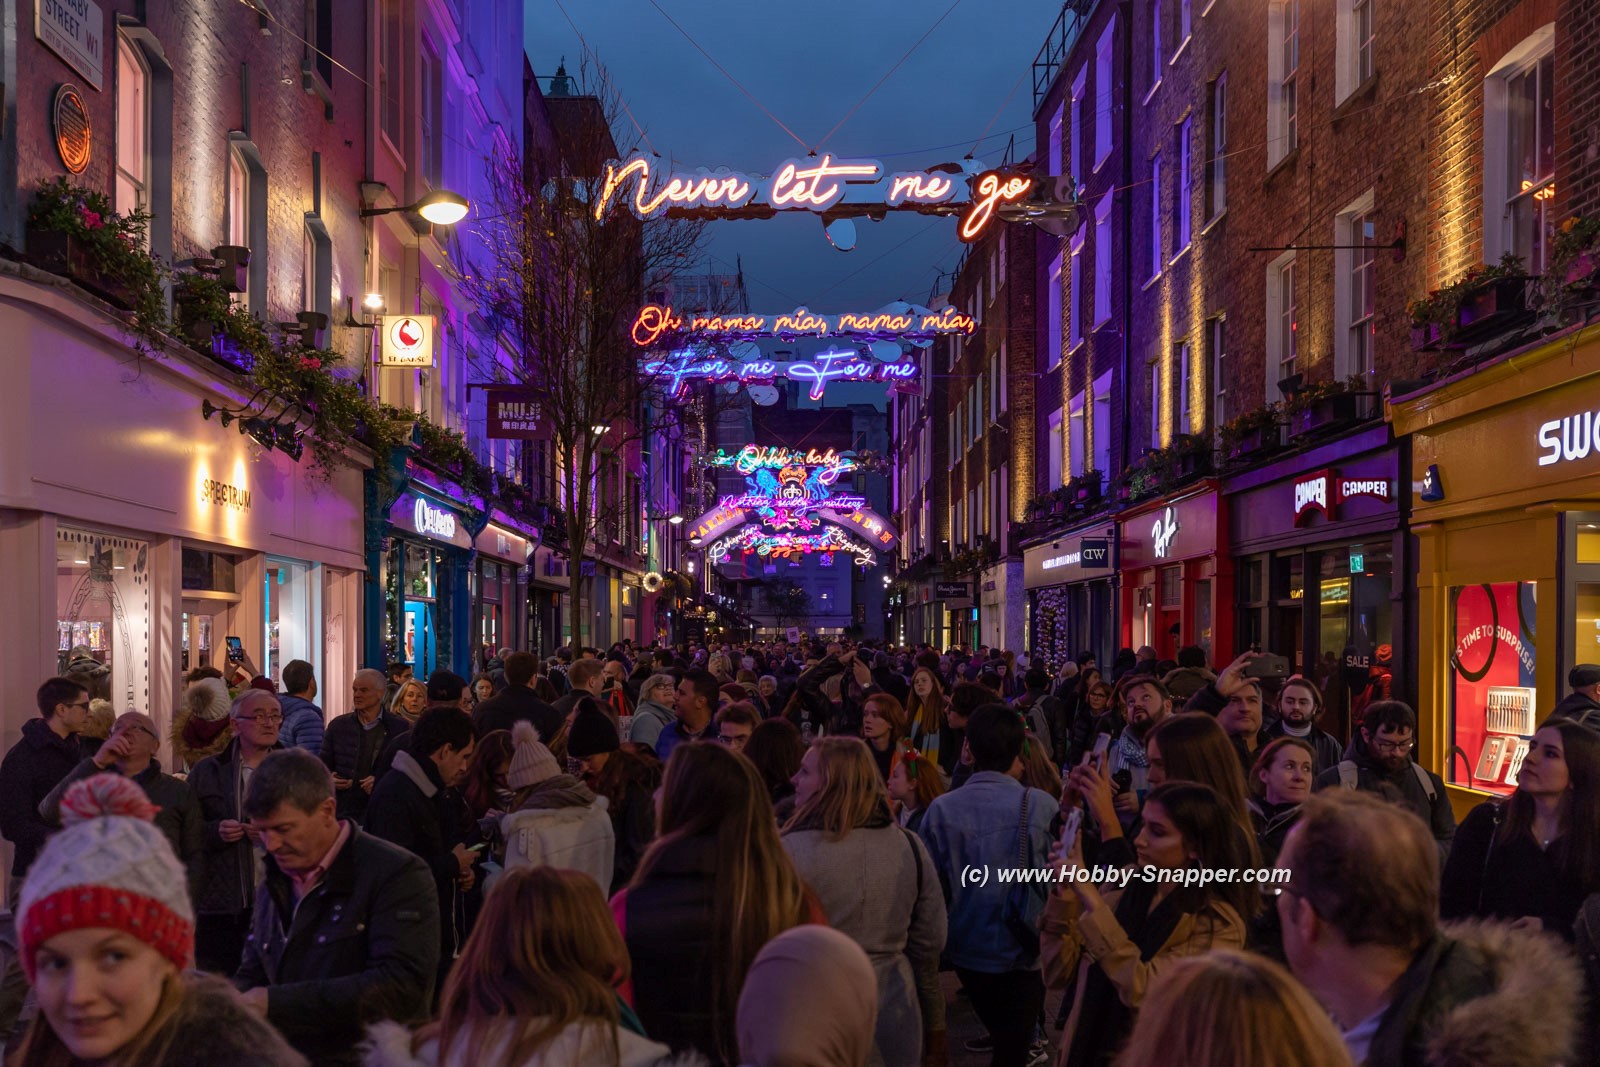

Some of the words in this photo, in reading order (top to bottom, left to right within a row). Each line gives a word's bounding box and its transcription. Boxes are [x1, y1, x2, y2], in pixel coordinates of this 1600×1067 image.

[46, 0, 80, 41] STREET
[86, 29, 98, 60] W1
[594, 159, 749, 221] Never
[772, 154, 880, 205] let
[890, 174, 952, 202] me
[962, 174, 1032, 238] go
[631, 306, 682, 346] Oh
[691, 316, 764, 332] mama
[836, 313, 912, 331] mama
[644, 346, 729, 396] For
[740, 361, 776, 377] me
[787, 349, 872, 398] For
[881, 362, 916, 378] me
[497, 402, 541, 420] MUJI
[805, 448, 857, 486] baby
[203, 479, 252, 509] SPECTRUM
[1295, 477, 1326, 513] CAMPER
[1342, 481, 1388, 497] CAMPER
[689, 506, 751, 539] CARNAB
[1346, 655, 1369, 668] SALE
[1461, 626, 1481, 650] TIME
[1481, 624, 1494, 637] TO
[1495, 625, 1536, 676] SURPRISE!
